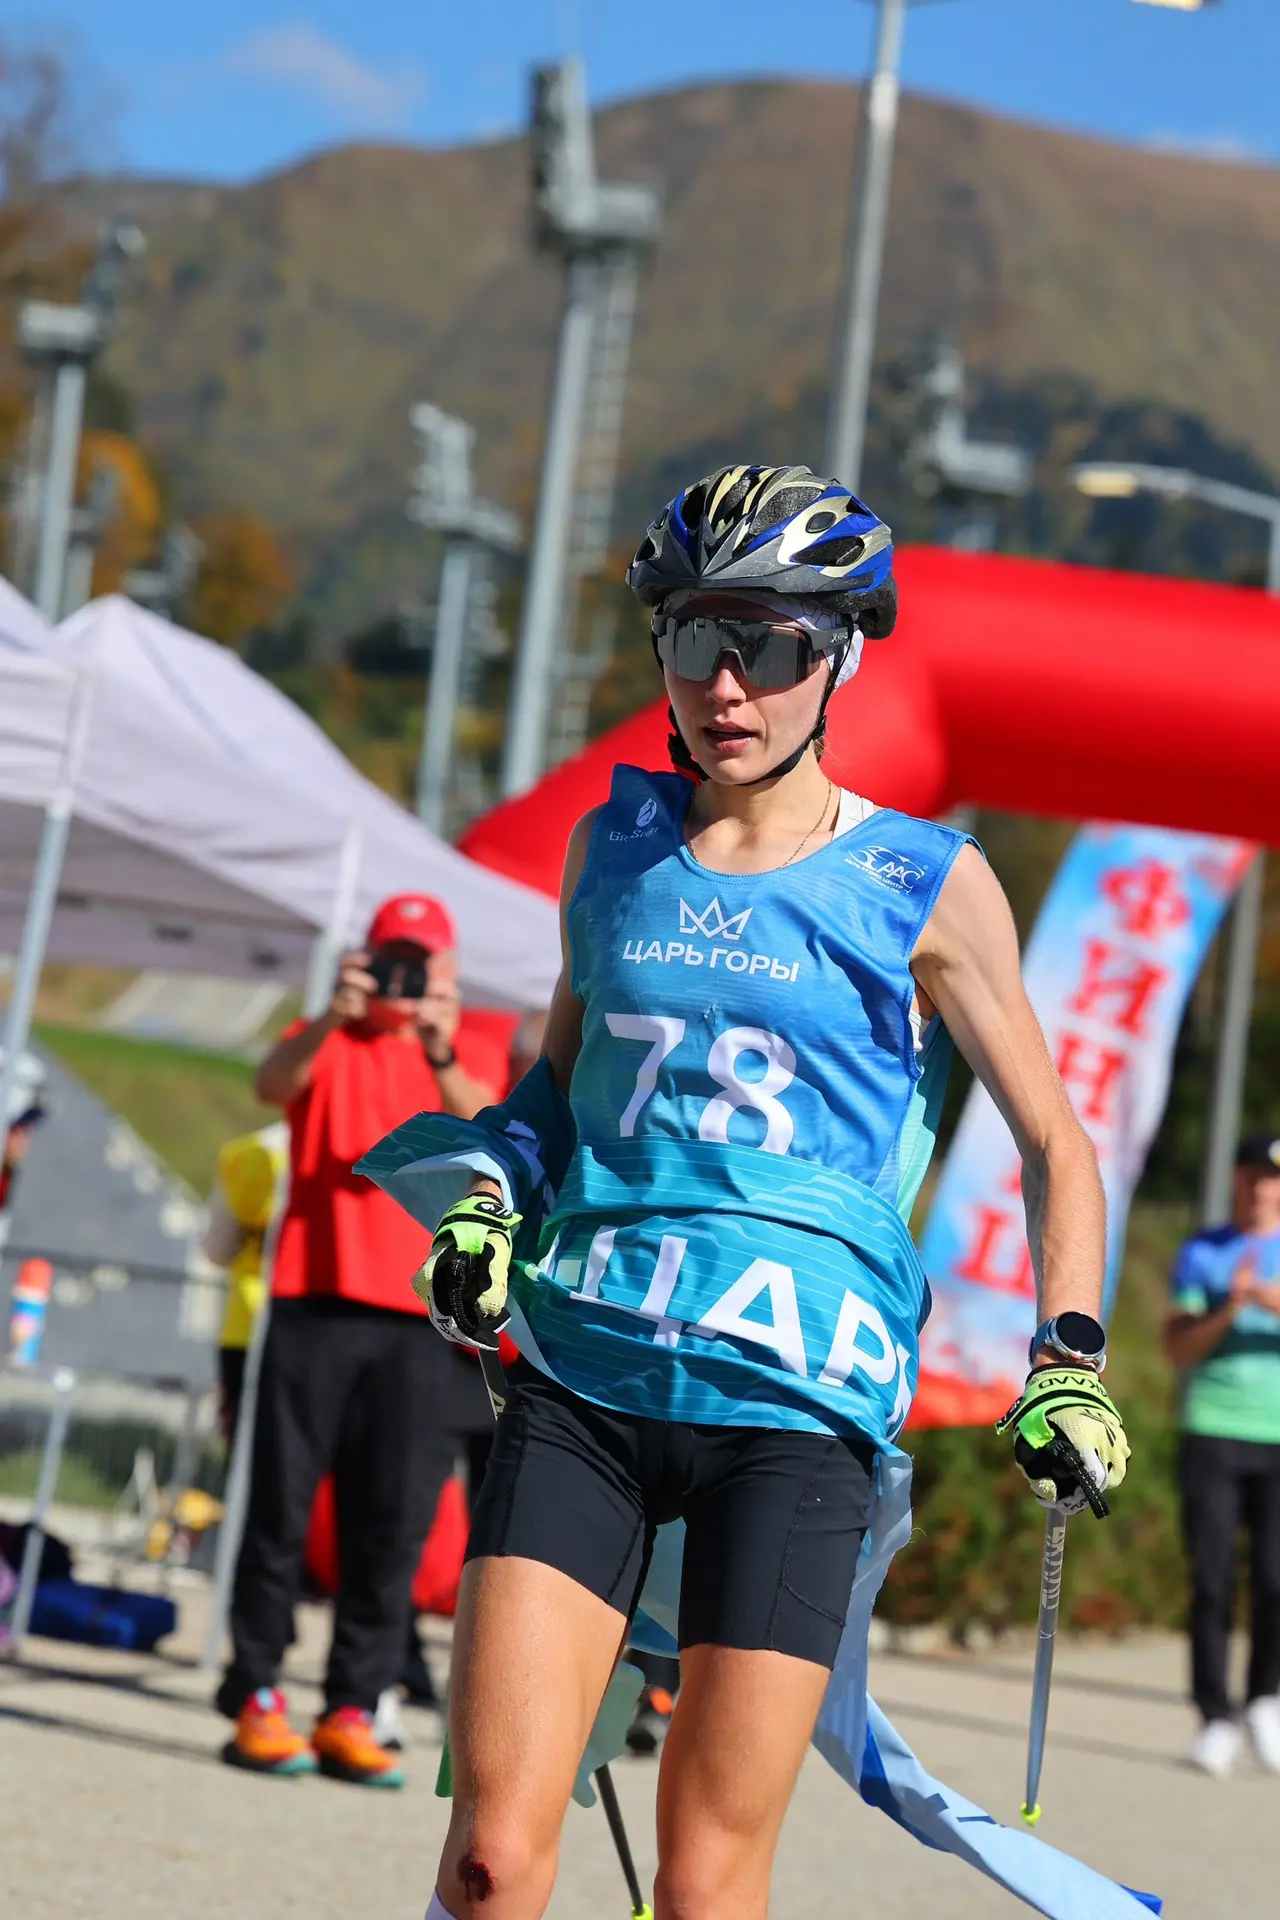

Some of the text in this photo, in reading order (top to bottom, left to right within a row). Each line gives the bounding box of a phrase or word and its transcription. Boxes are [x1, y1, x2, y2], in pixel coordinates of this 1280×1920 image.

[622, 940, 800, 983] ЦАРЬ ГОРЫ
[605, 1012, 797, 1155] 78
